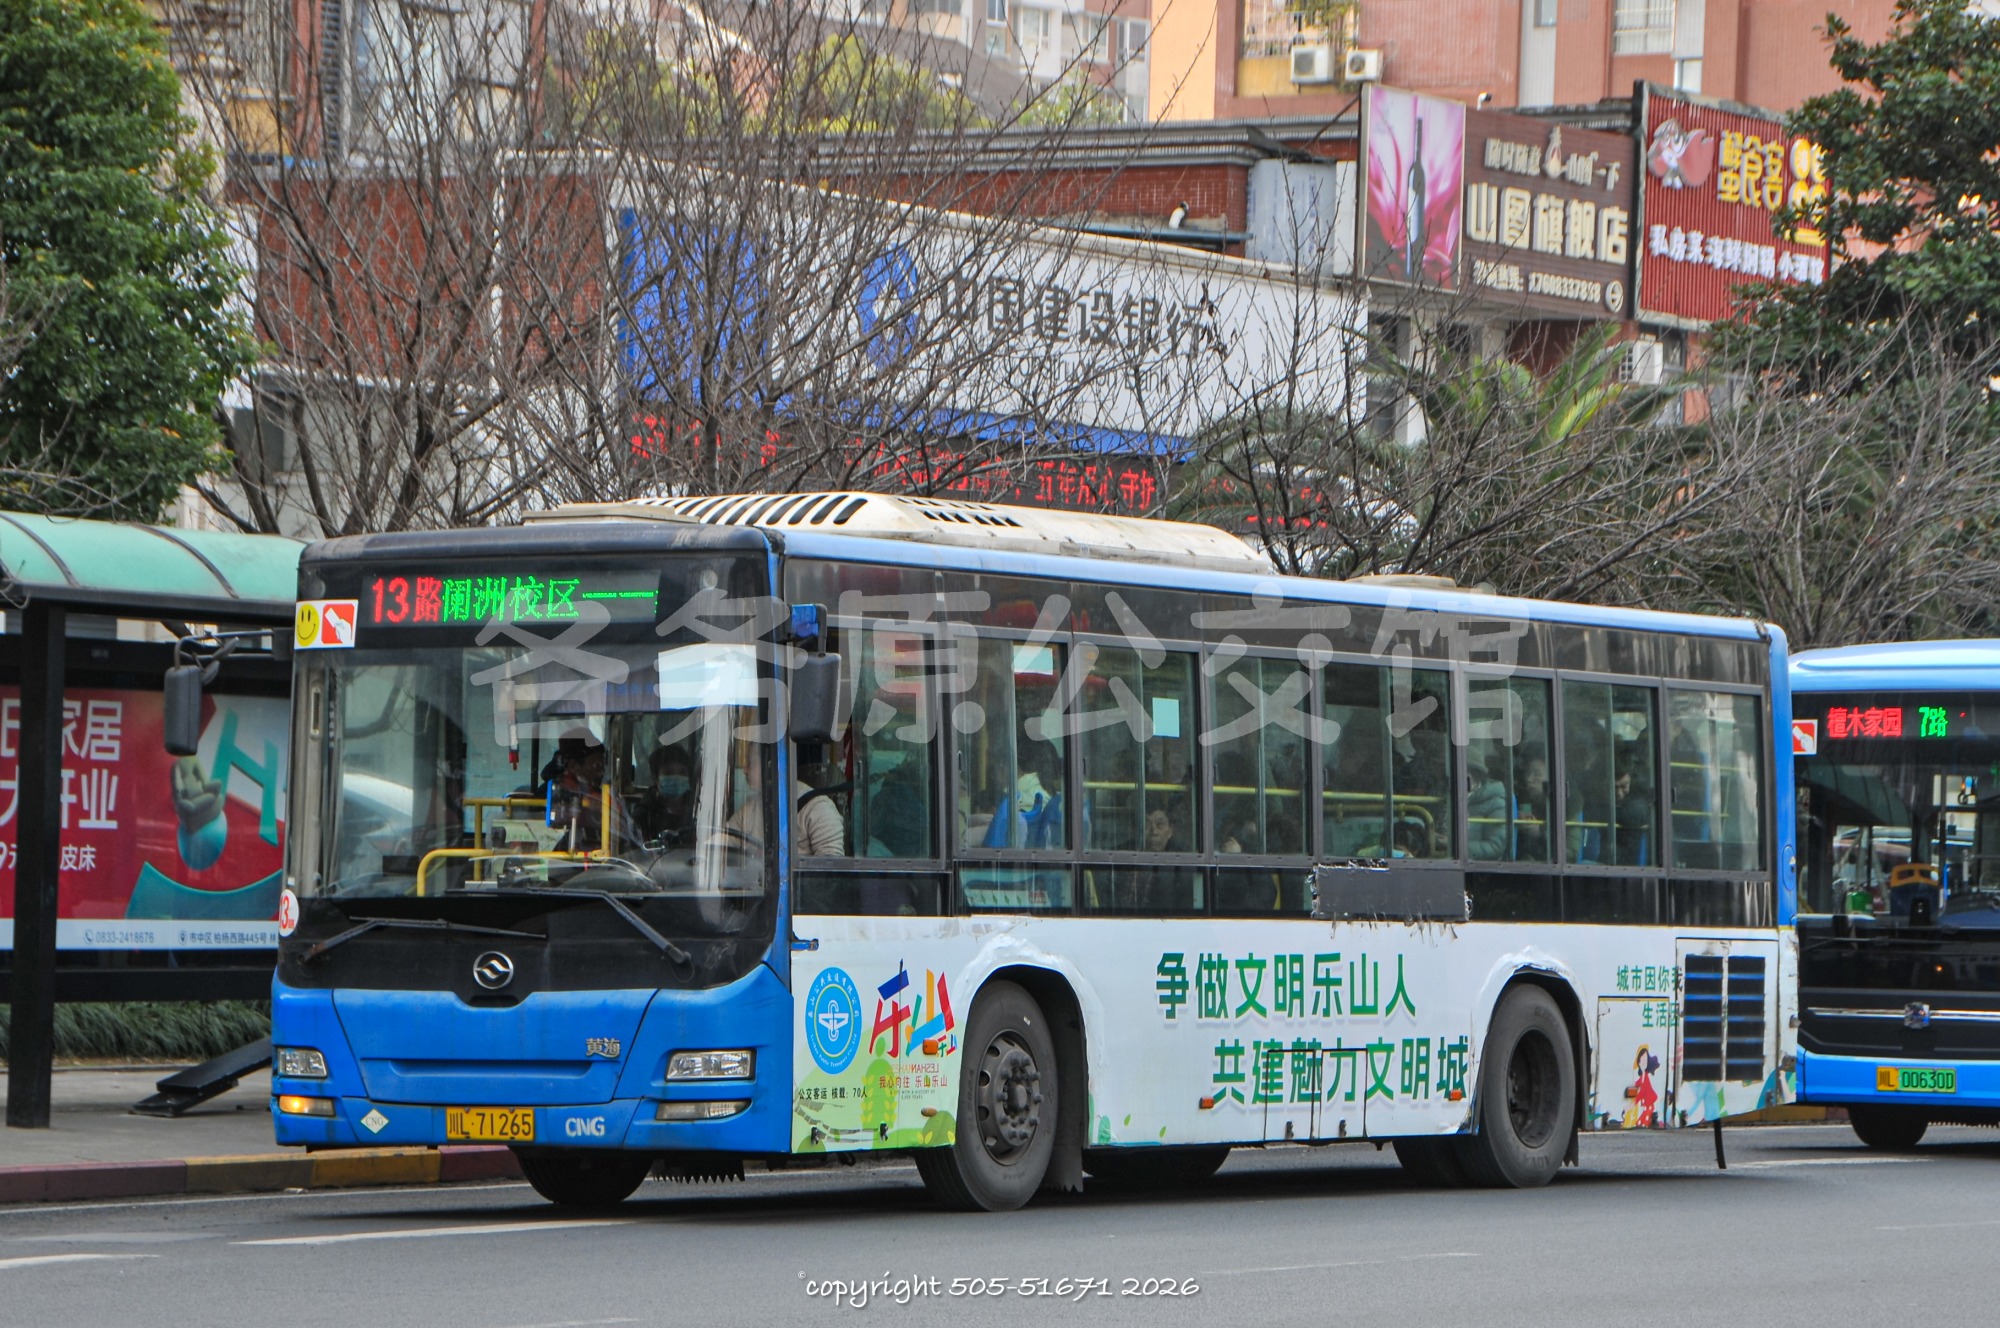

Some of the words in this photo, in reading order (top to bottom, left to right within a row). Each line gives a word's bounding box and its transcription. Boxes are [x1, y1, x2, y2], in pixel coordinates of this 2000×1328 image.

[1467, 182, 1628, 265] 山图旗舰店
[941, 270, 1207, 358] 中国建设银行
[372, 577, 441, 623] 13路
[1827, 707, 1903, 738] 檀木家园
[1919, 706, 1948, 738] 7路
[1156, 952, 1416, 1020] 争做文明乐山人
[1617, 964, 1683, 992] 城市因你我
[585, 1038, 621, 1058] 黄海
[1213, 1035, 1468, 1104] 共建魅力文明城
[799, 1088, 827, 1100] 公交客运
[853, 1086, 867, 1099] 70人
[365, 1115, 385, 1127] CNG
[565, 1116, 606, 1137] CNG
